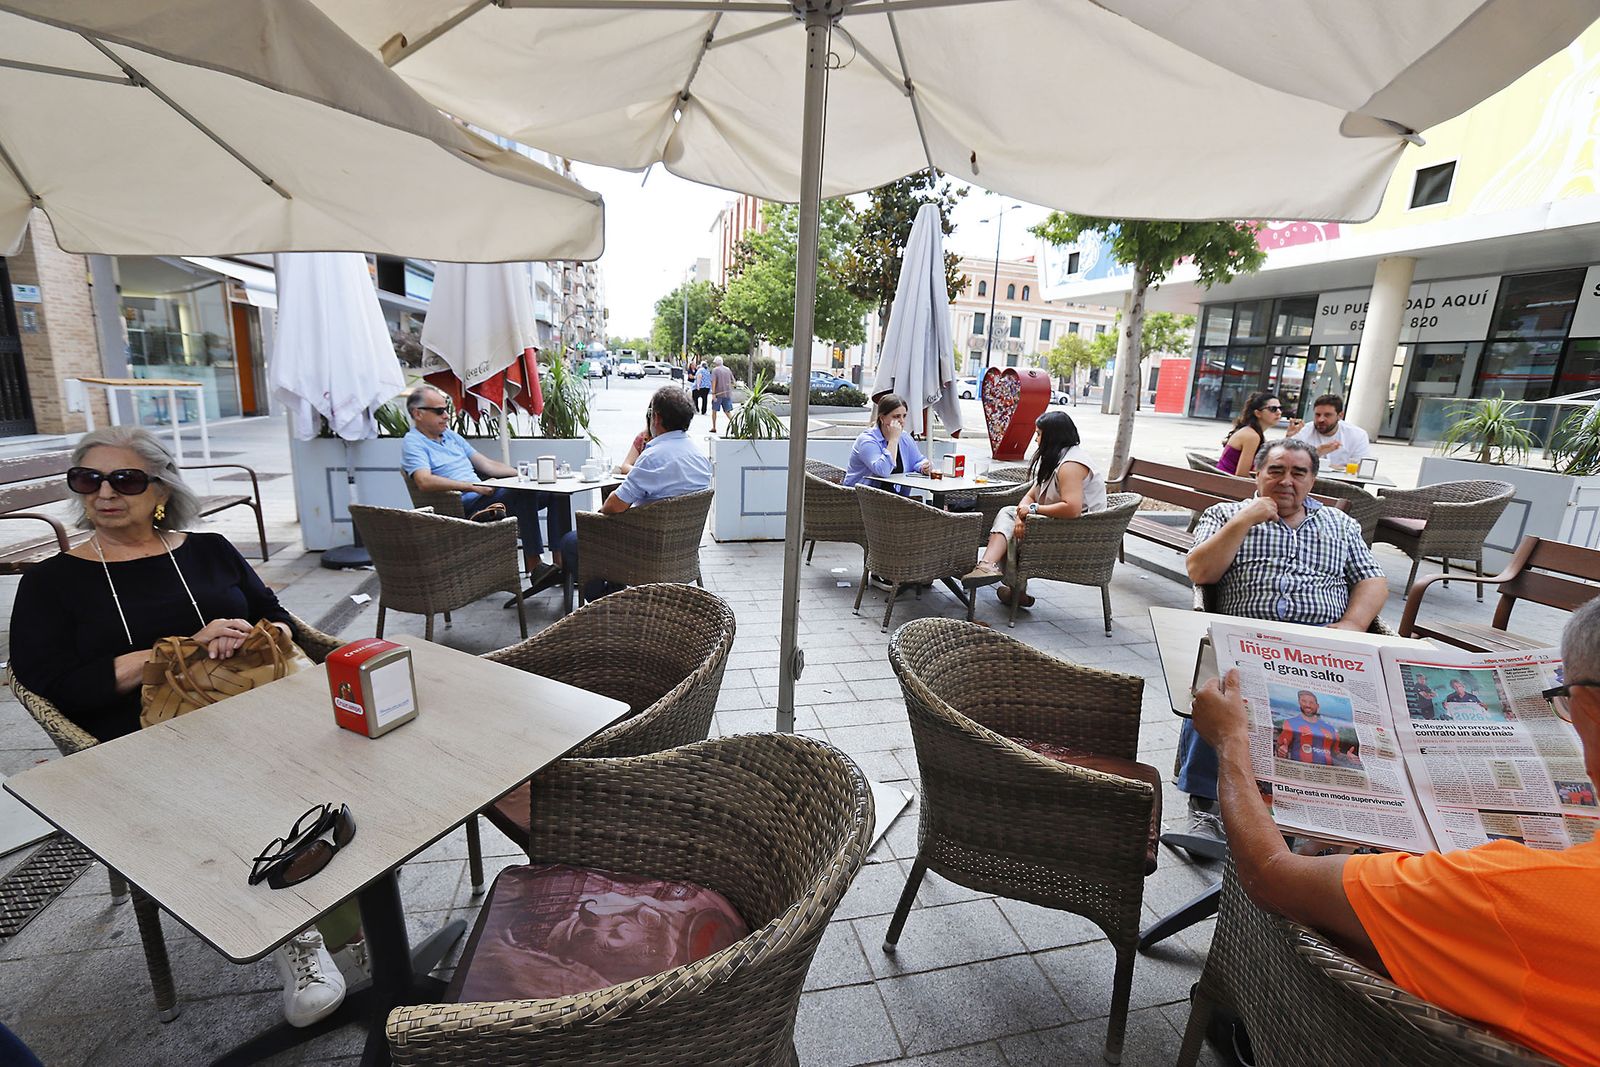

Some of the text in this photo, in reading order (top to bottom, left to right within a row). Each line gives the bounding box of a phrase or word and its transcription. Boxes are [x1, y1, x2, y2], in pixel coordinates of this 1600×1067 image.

[1321, 305, 1339, 316] SU
[1442, 289, 1489, 308] AQUÍ
[1410, 315, 1438, 329] 820
[1239, 640, 1365, 672] Iñigo Martínez
[1263, 660, 1344, 683] el gran salto
[1412, 723, 1456, 731] Pellegrini
[1415, 729, 1455, 737] contrato
[1284, 785, 1304, 796] Barça
[1304, 788, 1319, 797] está
[1330, 792, 1350, 801] modo
